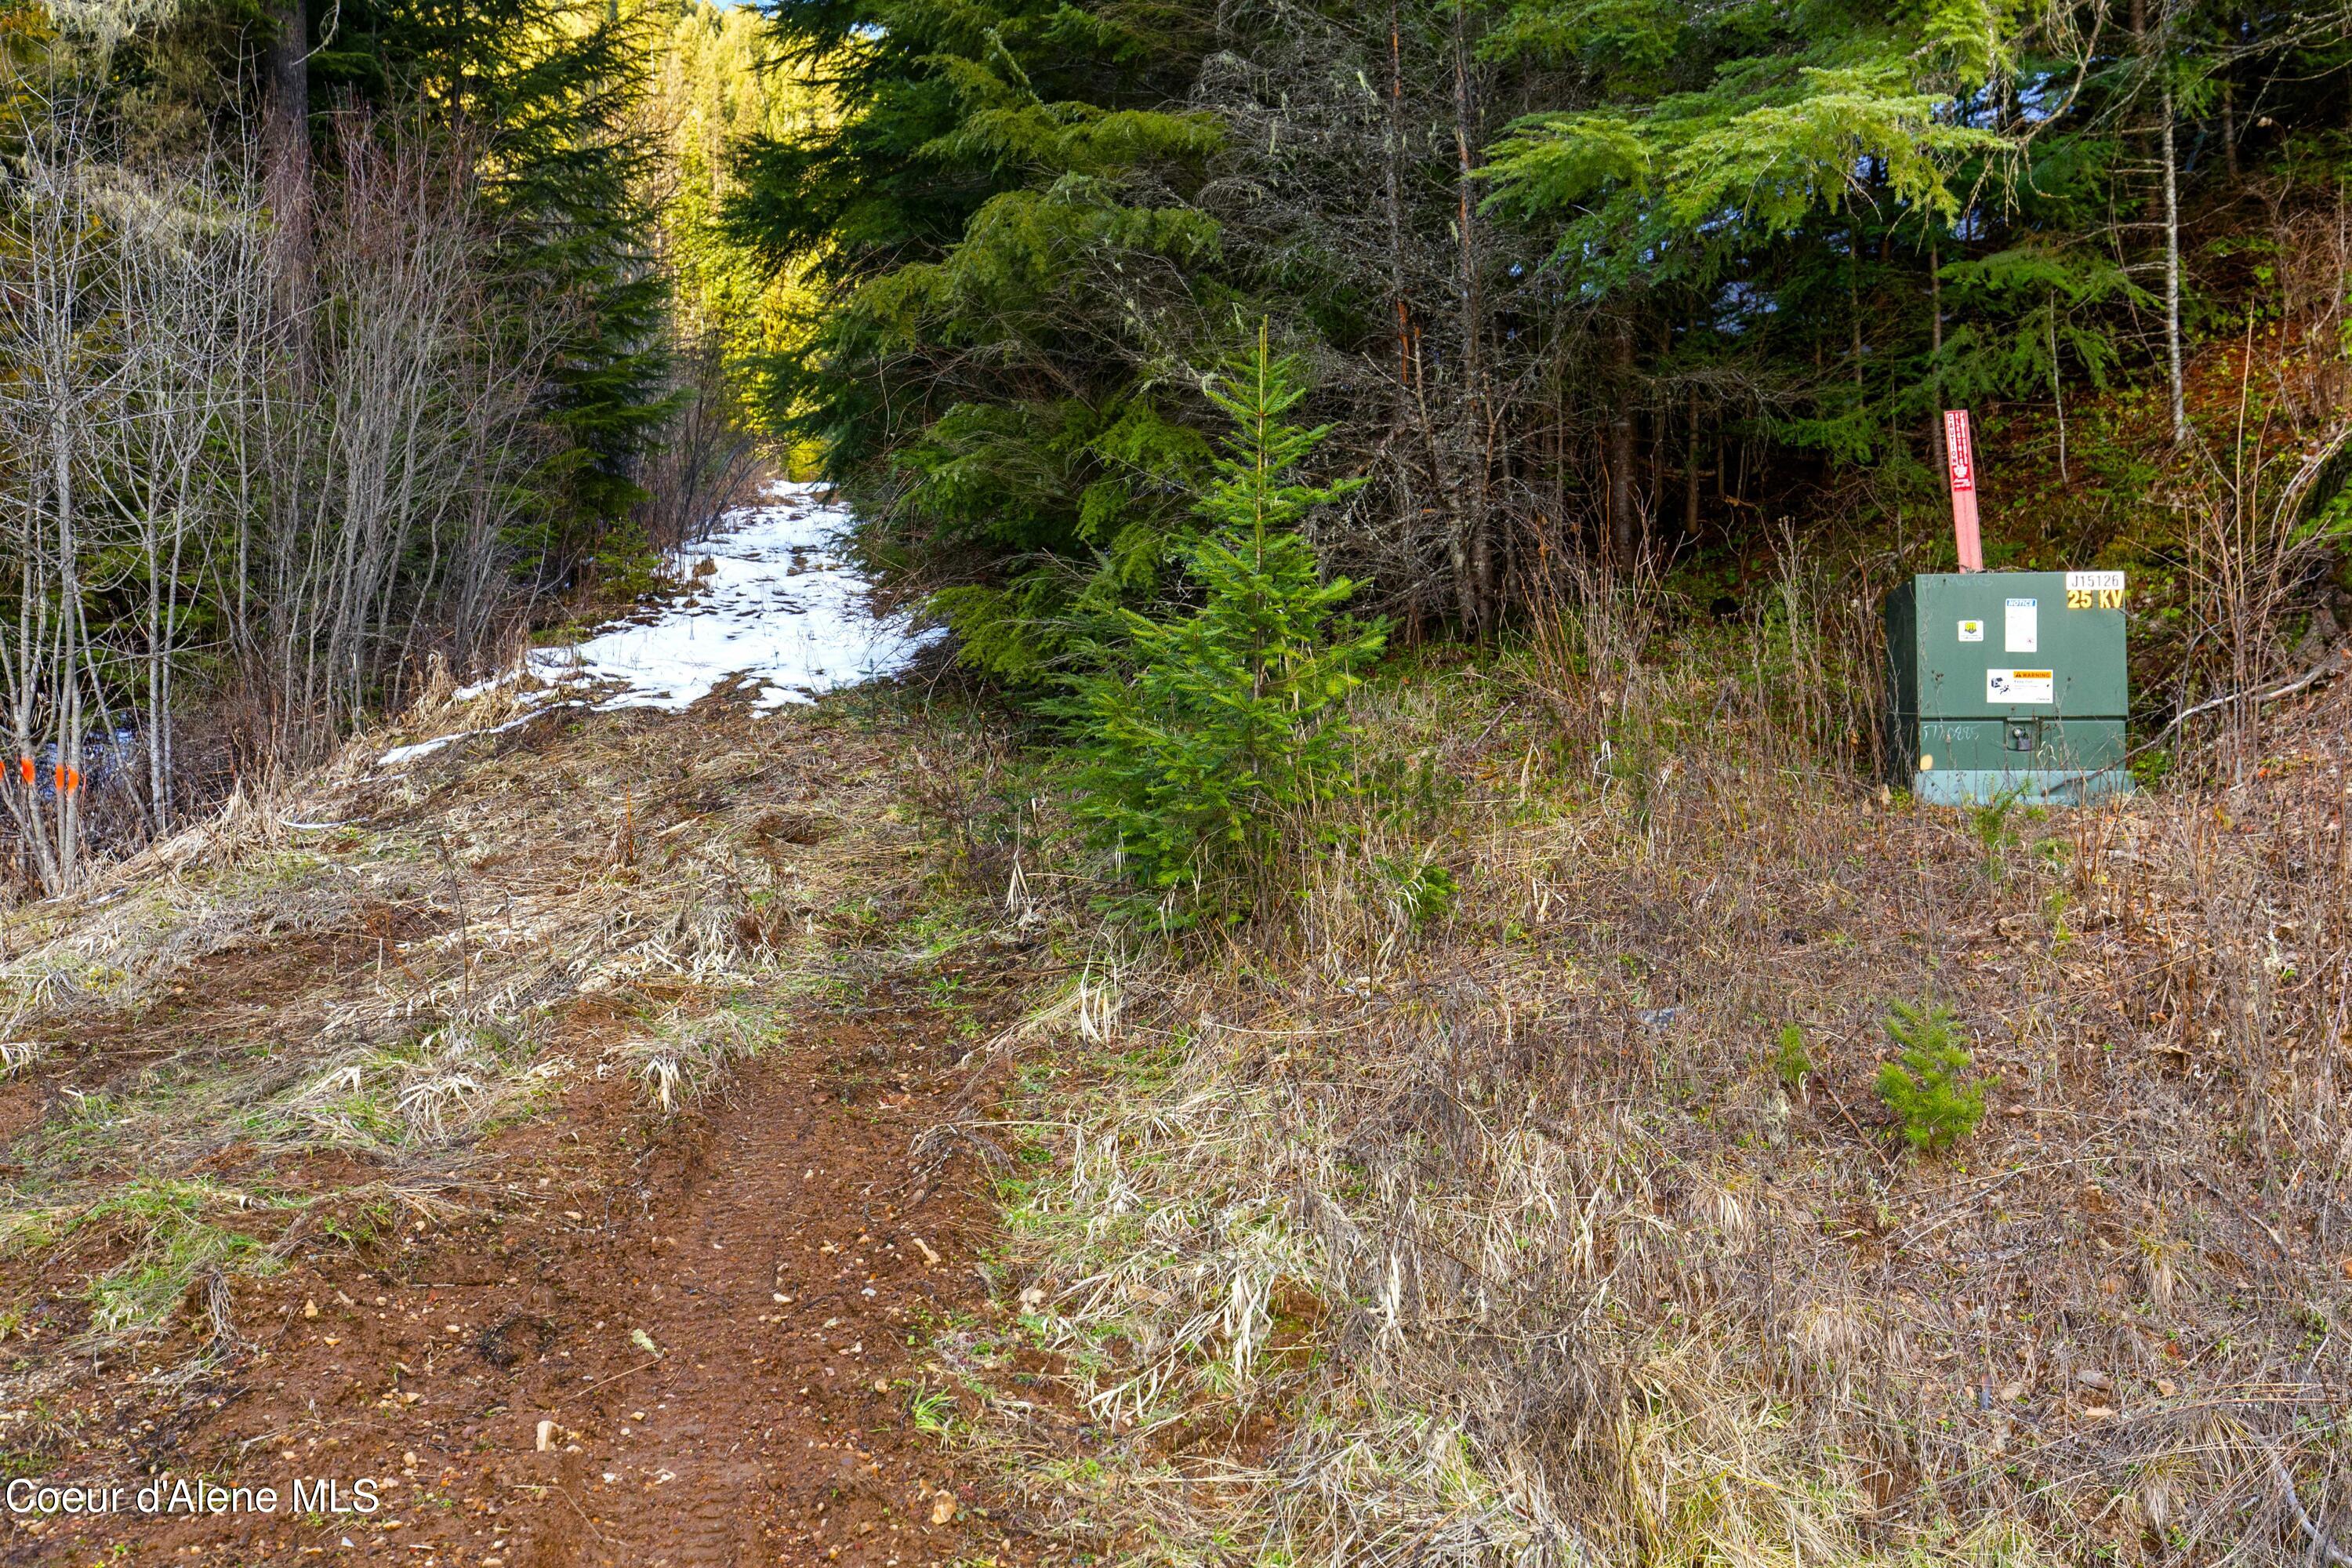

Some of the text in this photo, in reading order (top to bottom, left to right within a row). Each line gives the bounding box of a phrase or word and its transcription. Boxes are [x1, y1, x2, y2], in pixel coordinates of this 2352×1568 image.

[1948, 415, 1957, 464] CAUTION
[1955, 412, 1963, 464] ELECTRIC
[2071, 575, 2119, 587] J15126
[2067, 590, 2123, 608] 25 KV
